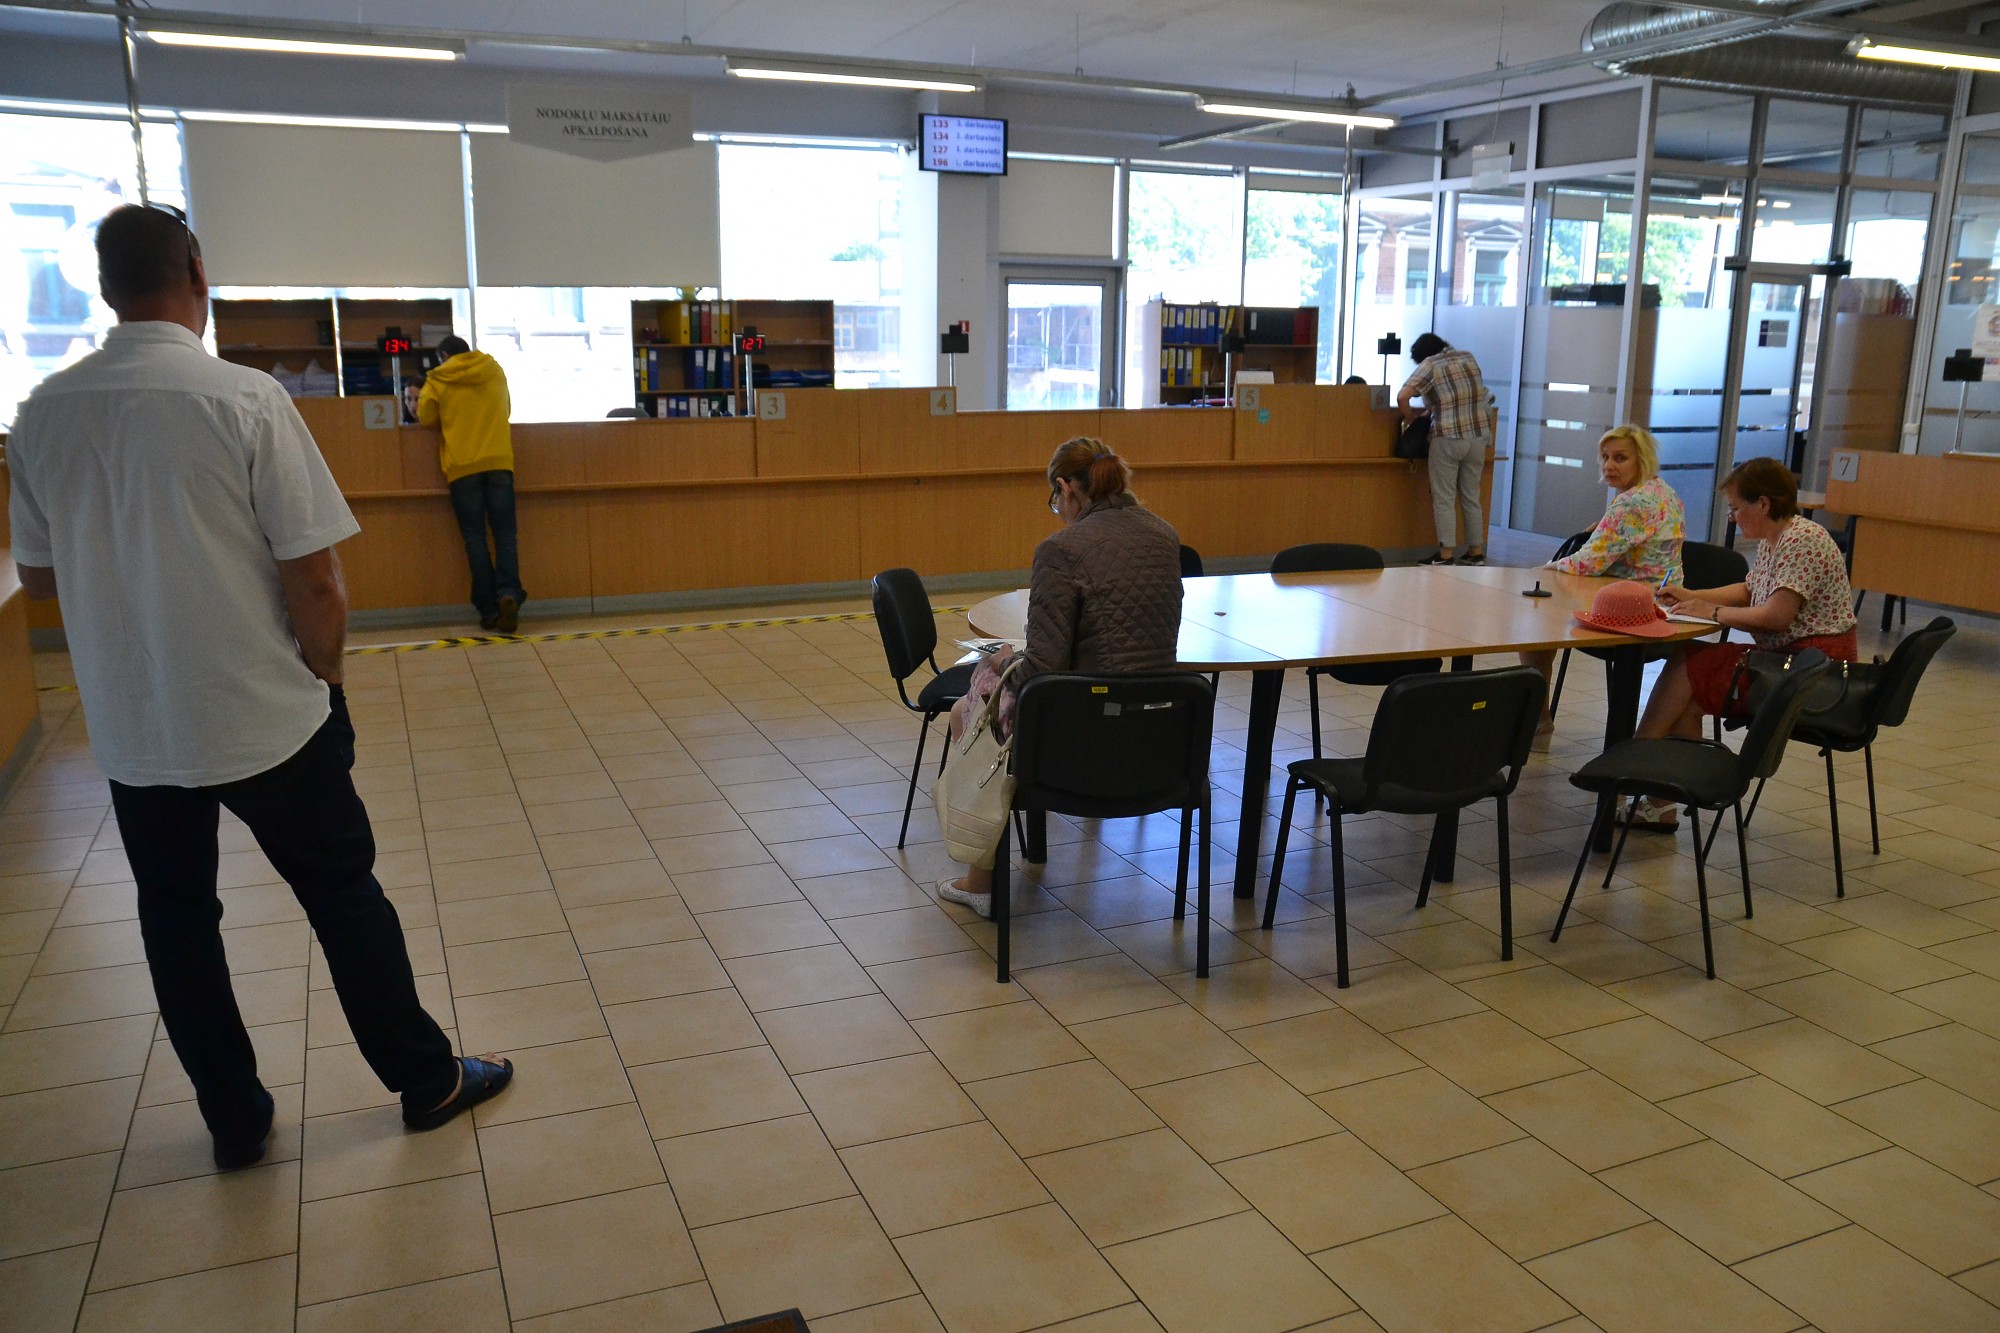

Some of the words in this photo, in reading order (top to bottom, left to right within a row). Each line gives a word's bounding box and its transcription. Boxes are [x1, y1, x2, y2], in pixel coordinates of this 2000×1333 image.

[932, 131, 949, 140] 134
[932, 145, 948, 153] 127
[385, 339, 409, 354] 134
[741, 337, 763, 351] 127
[767, 396, 779, 415] 3
[937, 393, 948, 411] 4
[1245, 390, 1255, 406] 5
[372, 403, 387, 424] 2
[1839, 456, 1852, 476] 7
